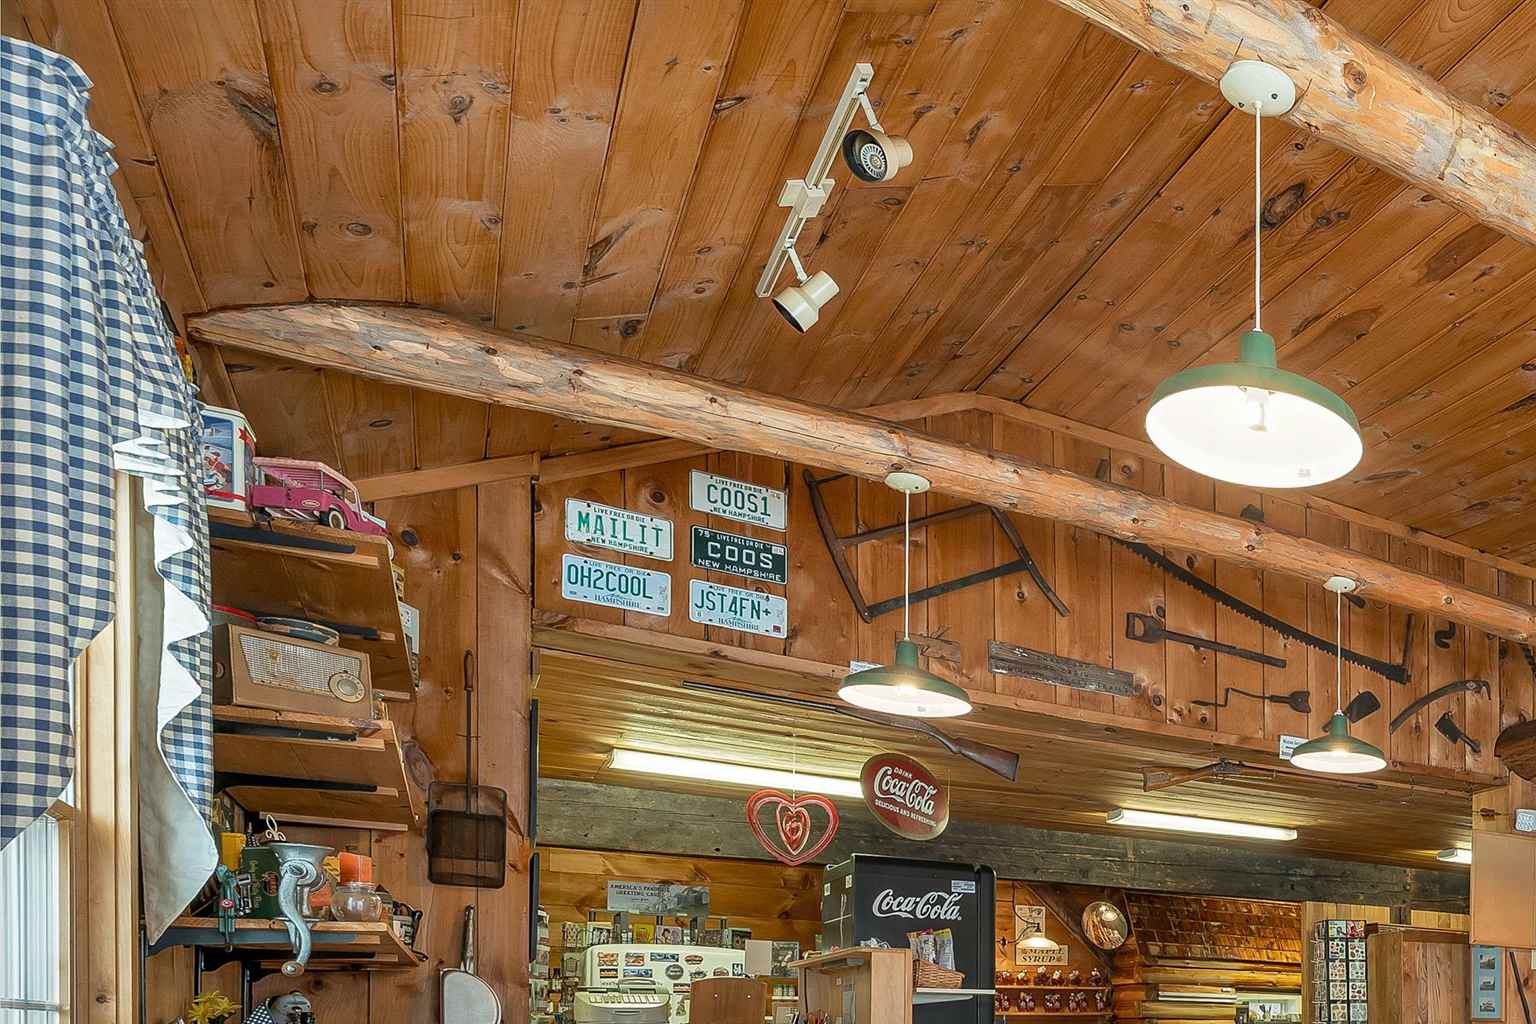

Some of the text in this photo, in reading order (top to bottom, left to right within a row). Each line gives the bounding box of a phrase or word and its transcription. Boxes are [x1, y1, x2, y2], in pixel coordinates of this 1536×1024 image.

[728, 509, 765, 523] HAMPSHIRE
[577, 511, 663, 547] MAILIT
[608, 540, 648, 553] HAMPSHIRE
[708, 541, 773, 569] COOS
[567, 564, 653, 599] OH2COOL
[698, 559, 782, 582] NEW HAMPSHIRE
[894, 767, 913, 779] DRINK
[874, 766, 938, 816] Coca-Cola
[872, 889, 964, 919] Coca-Cola
[1022, 955, 1056, 963] SYRUP
